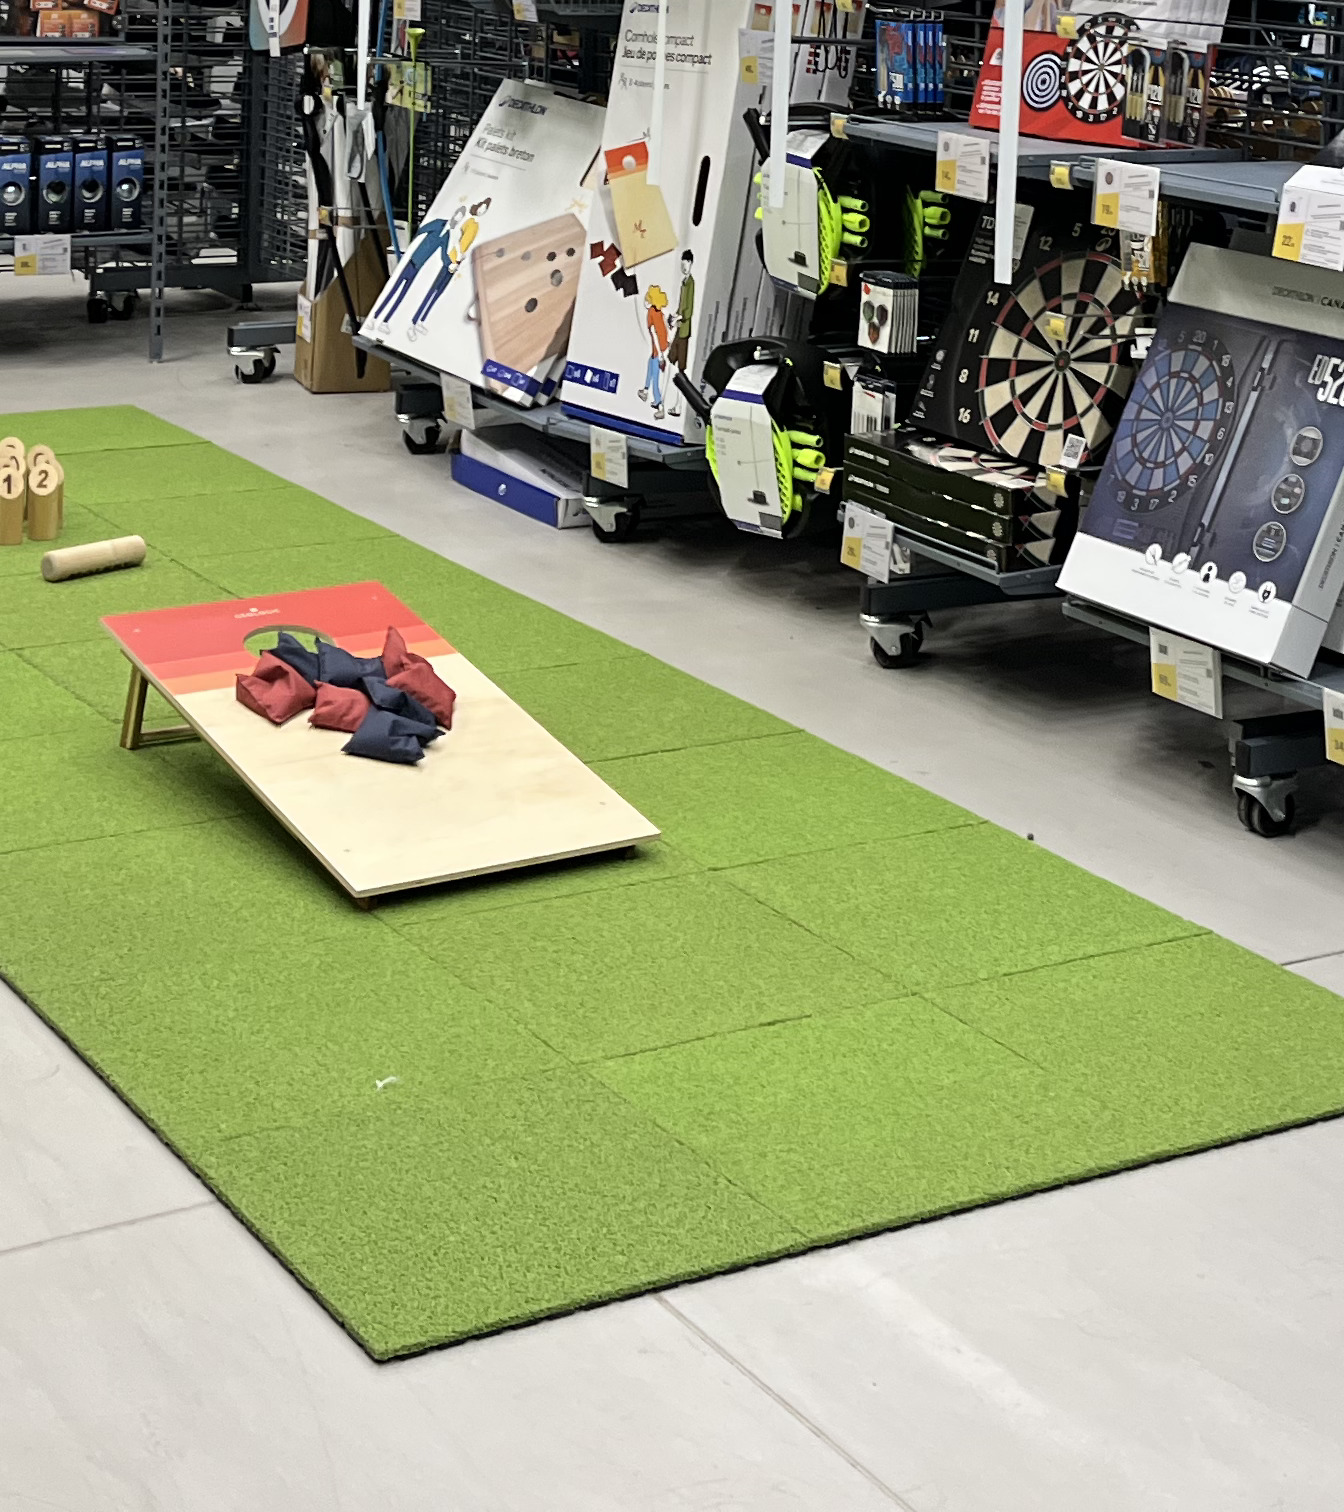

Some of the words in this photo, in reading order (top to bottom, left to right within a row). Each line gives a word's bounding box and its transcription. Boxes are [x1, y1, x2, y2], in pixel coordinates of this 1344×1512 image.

[664, 34, 695, 47] ompact
[1072, 222, 1082, 237] 5
[1039, 236, 1053, 251] 12
[987, 291, 1000, 306] 14
[968, 328, 980, 342] 11
[958, 369, 969, 383] 8
[958, 408, 971, 423] 16
[3, 474, 12, 494] 1
[36, 469, 49, 488] 2
